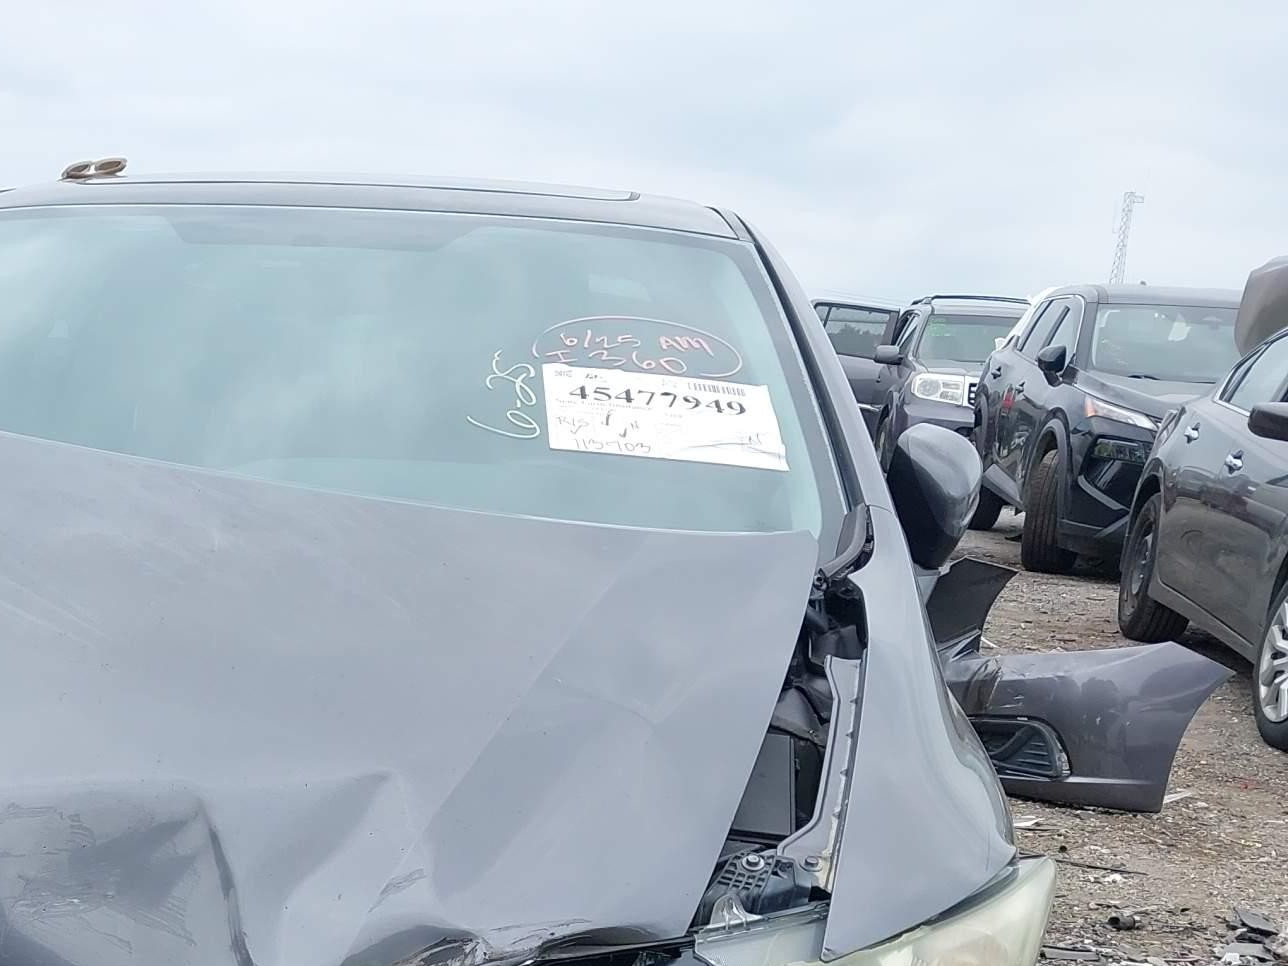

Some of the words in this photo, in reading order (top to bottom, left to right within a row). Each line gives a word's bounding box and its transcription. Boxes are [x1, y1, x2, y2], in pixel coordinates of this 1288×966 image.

[560, 329, 642, 350] 6/25
[658, 335, 715, 357] AM
[569, 384, 747, 416] 45477949
